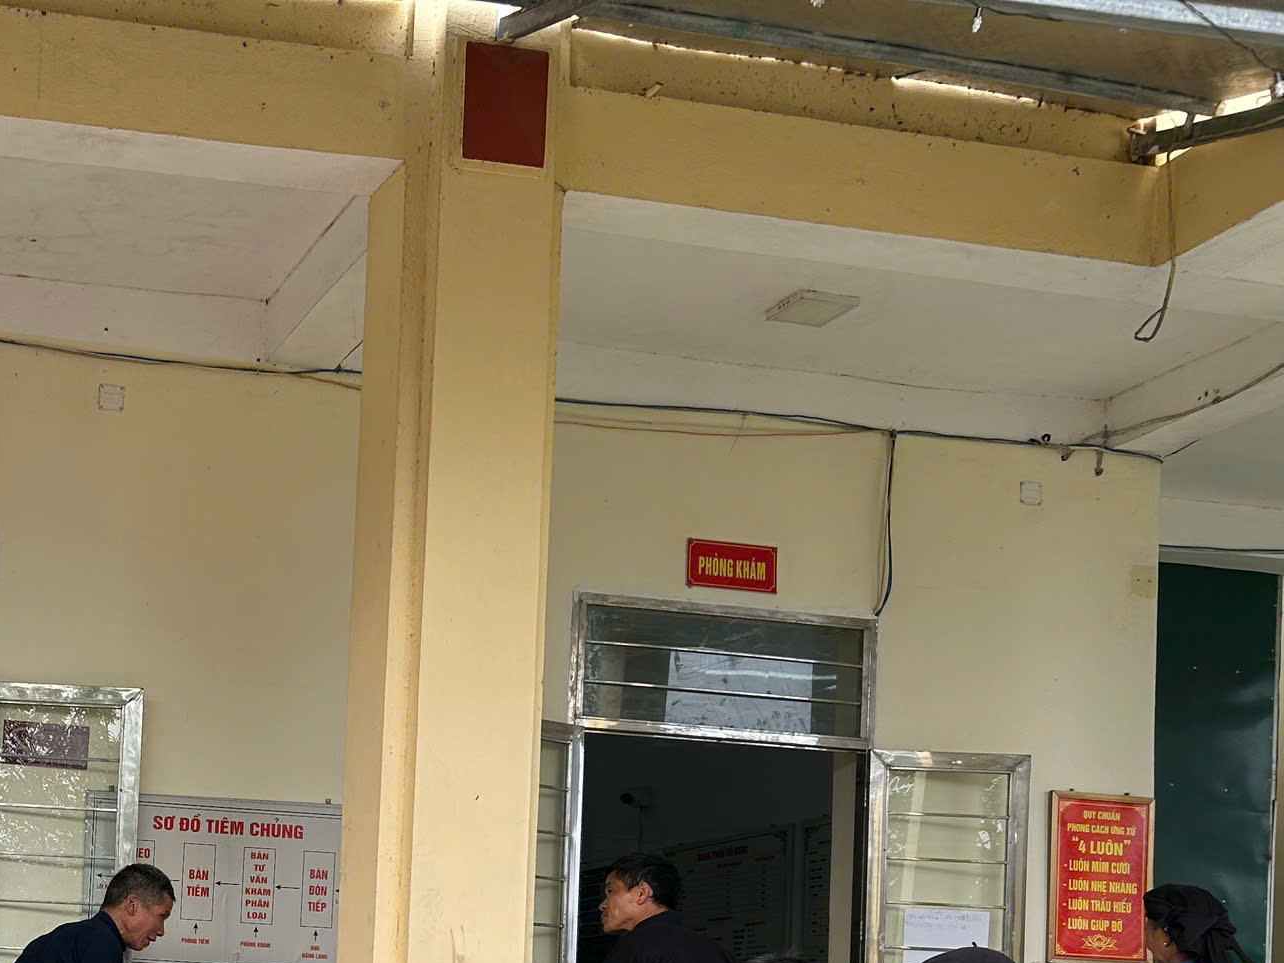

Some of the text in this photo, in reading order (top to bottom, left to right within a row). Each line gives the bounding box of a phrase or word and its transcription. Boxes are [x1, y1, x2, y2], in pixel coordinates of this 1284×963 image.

[698, 552, 766, 581] PHÒNG KHÁM
[153, 813, 304, 839] SƠ ĐỒ TIÊM CHỦNG
[136, 847, 151, 859] EO
[1069, 858, 1090, 871] LUÔN
[188, 867, 209, 880] BÀN
[309, 867, 328, 880] BÀN
[308, 883, 327, 896] ĐÓN
[1068, 877, 1089, 891] LUÔN
[187, 885, 210, 897] TIÊM
[245, 886, 271, 896] KHÁM
[307, 898, 327, 912] TIẾP
[1068, 896, 1089, 911] LUÔN
[247, 911, 267, 921] LOẠI
[1067, 916, 1089, 930] LUÔN
